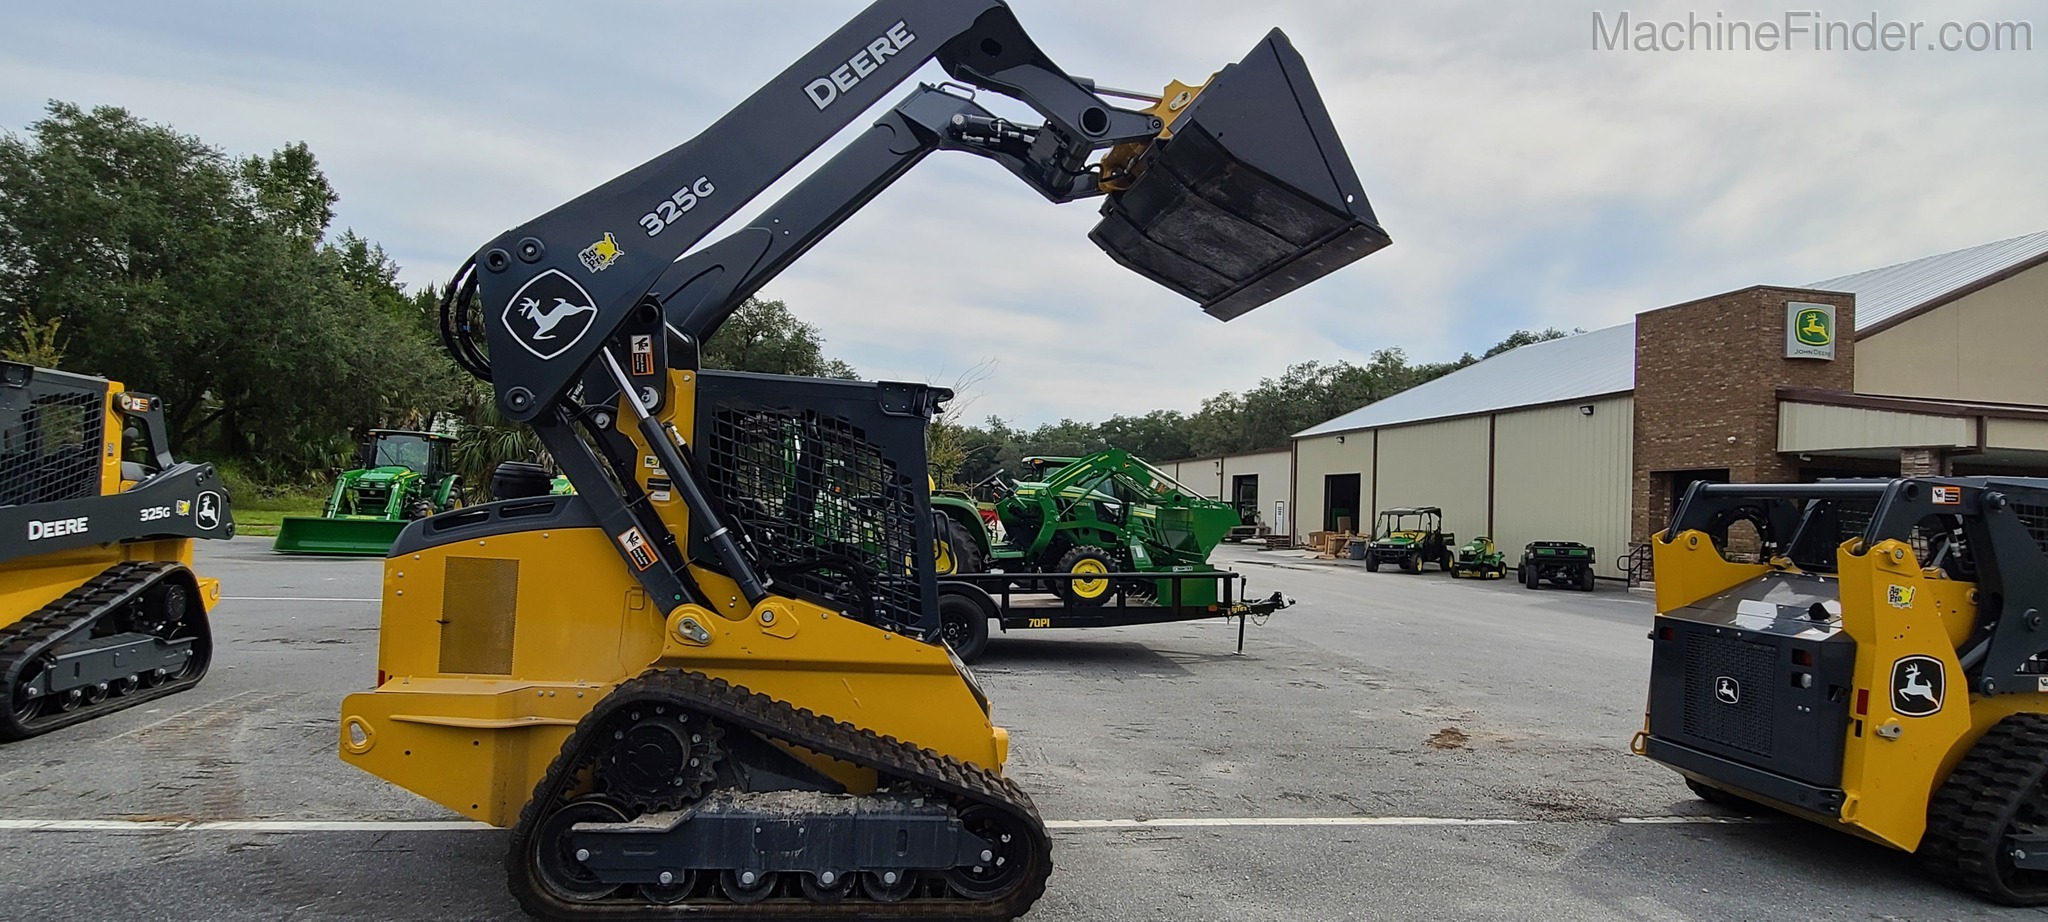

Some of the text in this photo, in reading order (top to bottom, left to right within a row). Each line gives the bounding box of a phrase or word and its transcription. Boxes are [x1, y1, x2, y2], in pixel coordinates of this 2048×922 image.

[803, 19, 917, 111] DEERE
[638, 175, 716, 237] 325G
[588, 253, 606, 269] Pro
[1813, 349, 1832, 357] DEERE
[139, 506, 171, 522] 325G
[28, 516, 89, 541] DEERE
